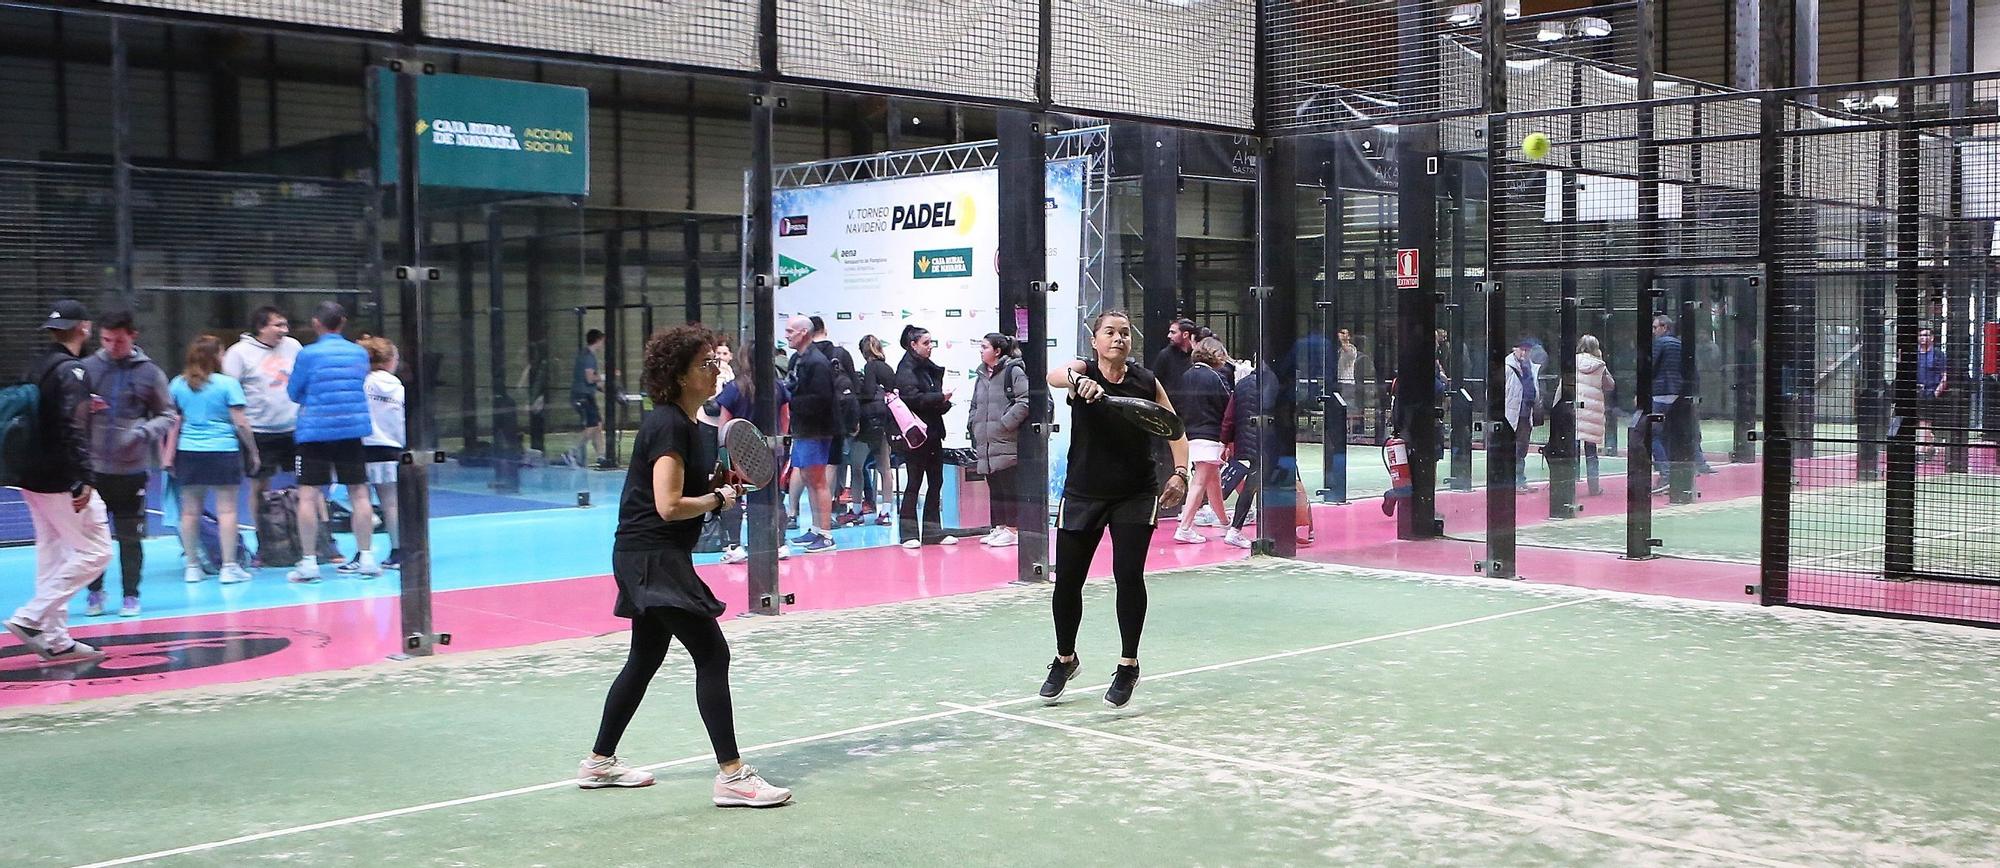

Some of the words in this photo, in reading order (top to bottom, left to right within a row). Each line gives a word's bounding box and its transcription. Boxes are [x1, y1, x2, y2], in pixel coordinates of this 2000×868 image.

[523, 127, 573, 142] ACCIÓN
[523, 140, 573, 155] SOCIAL
[857, 207, 889, 219] TORNEO
[891, 202, 956, 231] PADEL
[846, 218, 887, 233] NAVIDEÑO
[841, 250, 857, 258] aena
